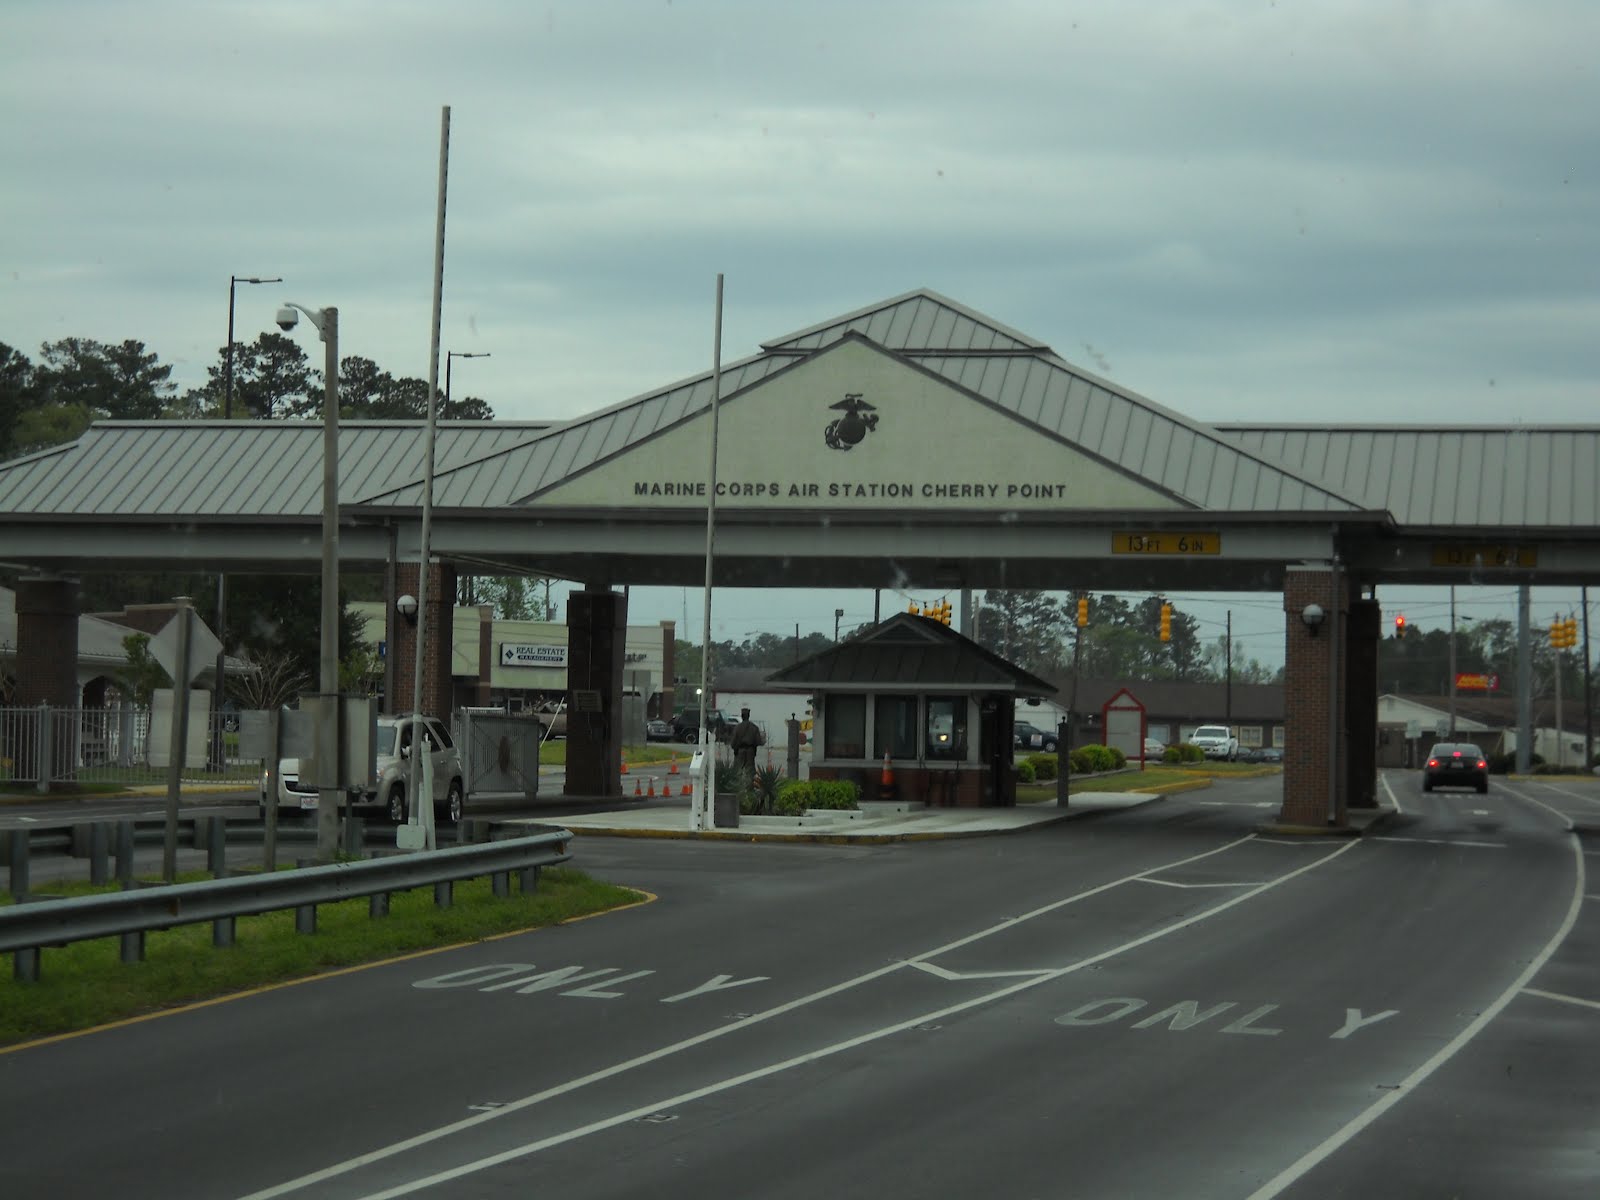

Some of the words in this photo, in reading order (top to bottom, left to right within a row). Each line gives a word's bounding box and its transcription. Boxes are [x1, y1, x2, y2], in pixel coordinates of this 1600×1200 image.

[634, 482, 706, 496] MARINE
[715, 482, 780, 497] CORPS
[788, 483, 819, 497] AIR
[828, 483, 913, 497] STATION
[921, 484, 999, 498] CHERRY
[1007, 484, 1066, 498] POINT
[1127, 535, 1144, 552] 13
[1178, 536, 1189, 552] 6
[1192, 539, 1204, 552] IN
[516, 647, 535, 655] REAL
[537, 648, 566, 656] ESTATE
[411, 963, 772, 1003] ONLY
[1053, 997, 1401, 1039] ONLY
